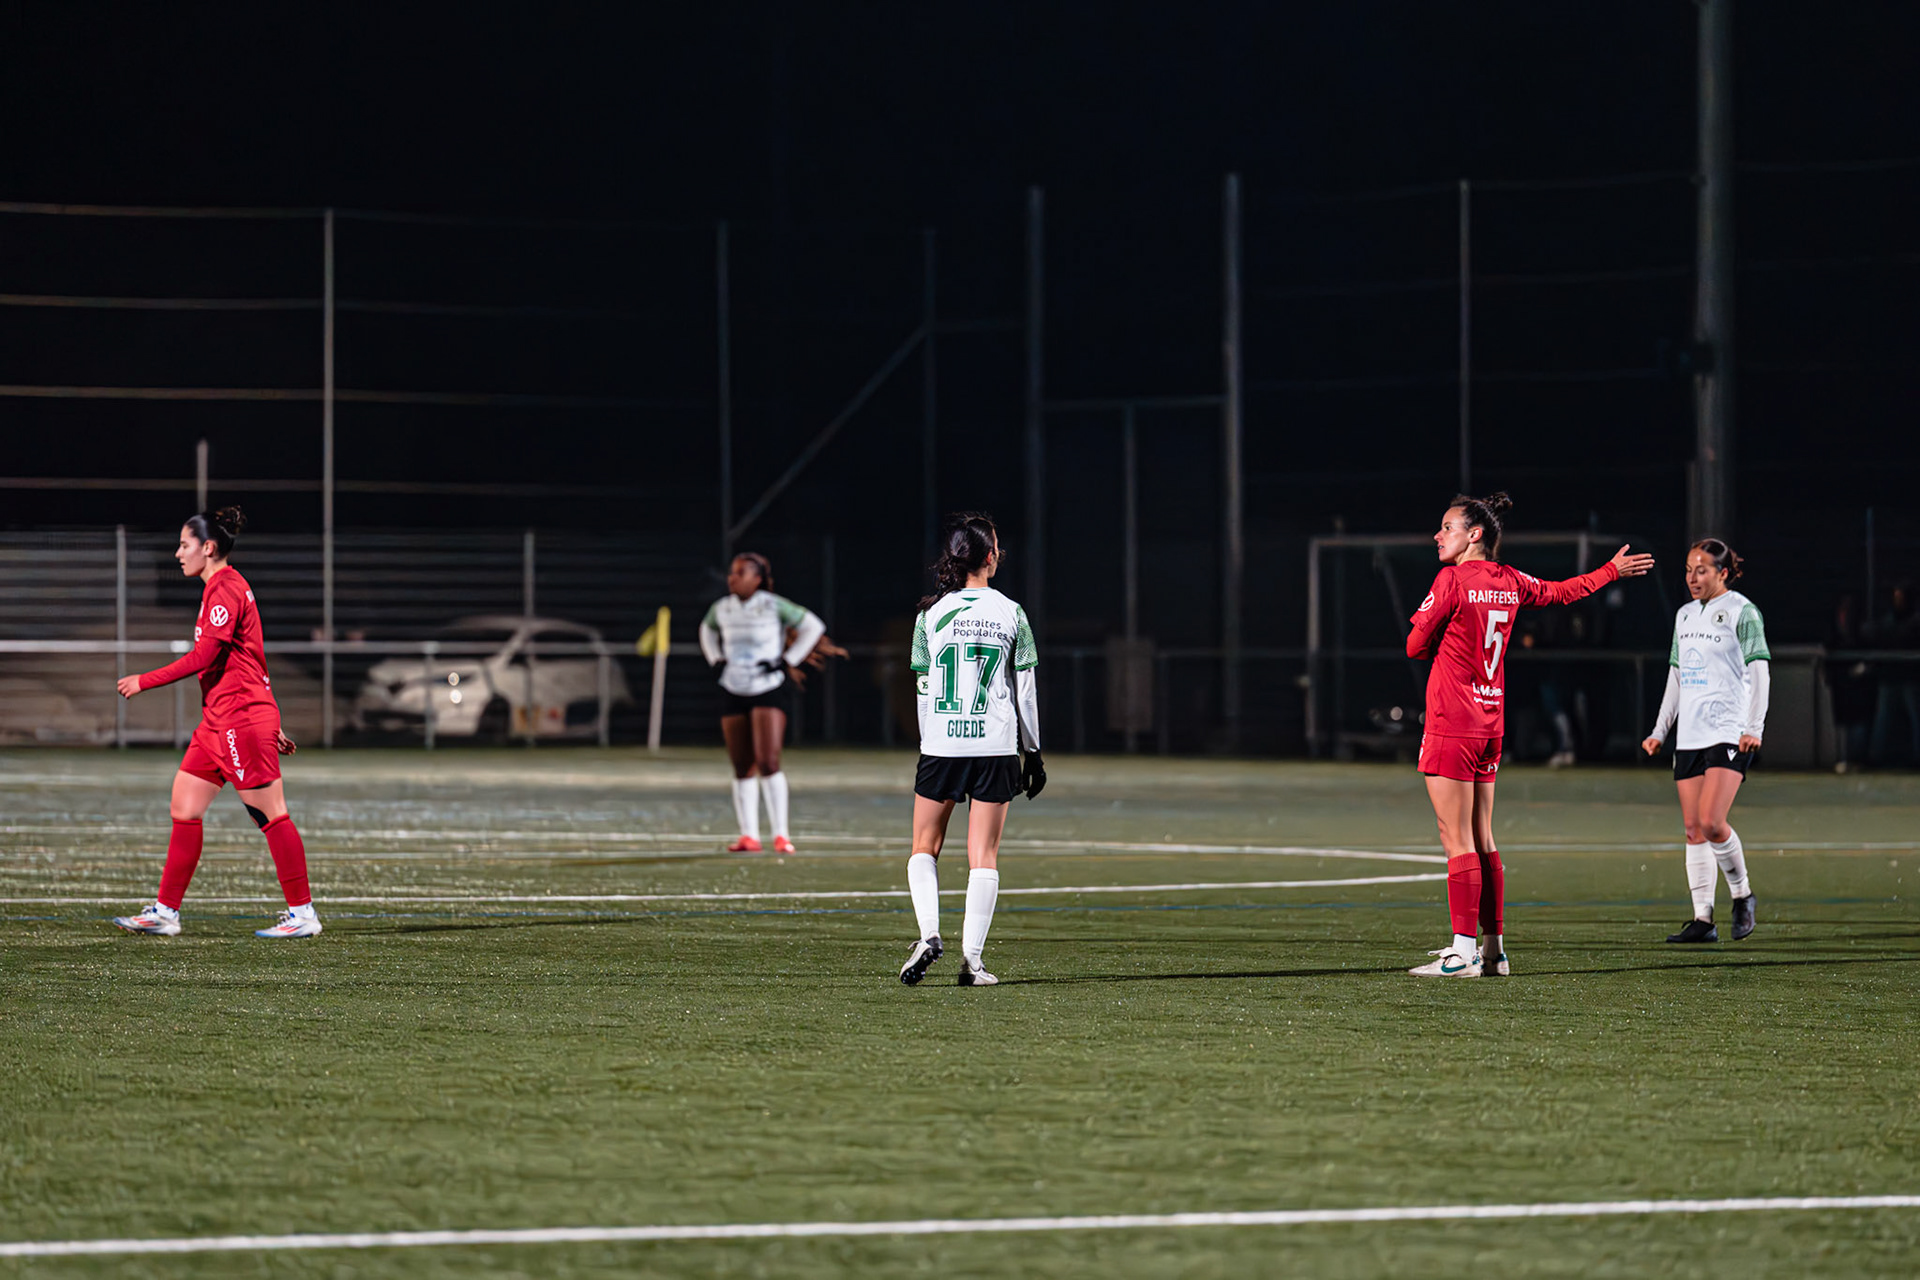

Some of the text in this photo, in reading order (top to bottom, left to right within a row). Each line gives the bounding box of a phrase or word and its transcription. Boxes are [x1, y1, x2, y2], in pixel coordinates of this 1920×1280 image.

[953, 619, 1002, 630] Retraites
[953, 628, 1008, 640] Populaires
[1484, 610, 1508, 681] 5
[935, 643, 1003, 715] 17
[947, 719, 986, 738] GUEDE
